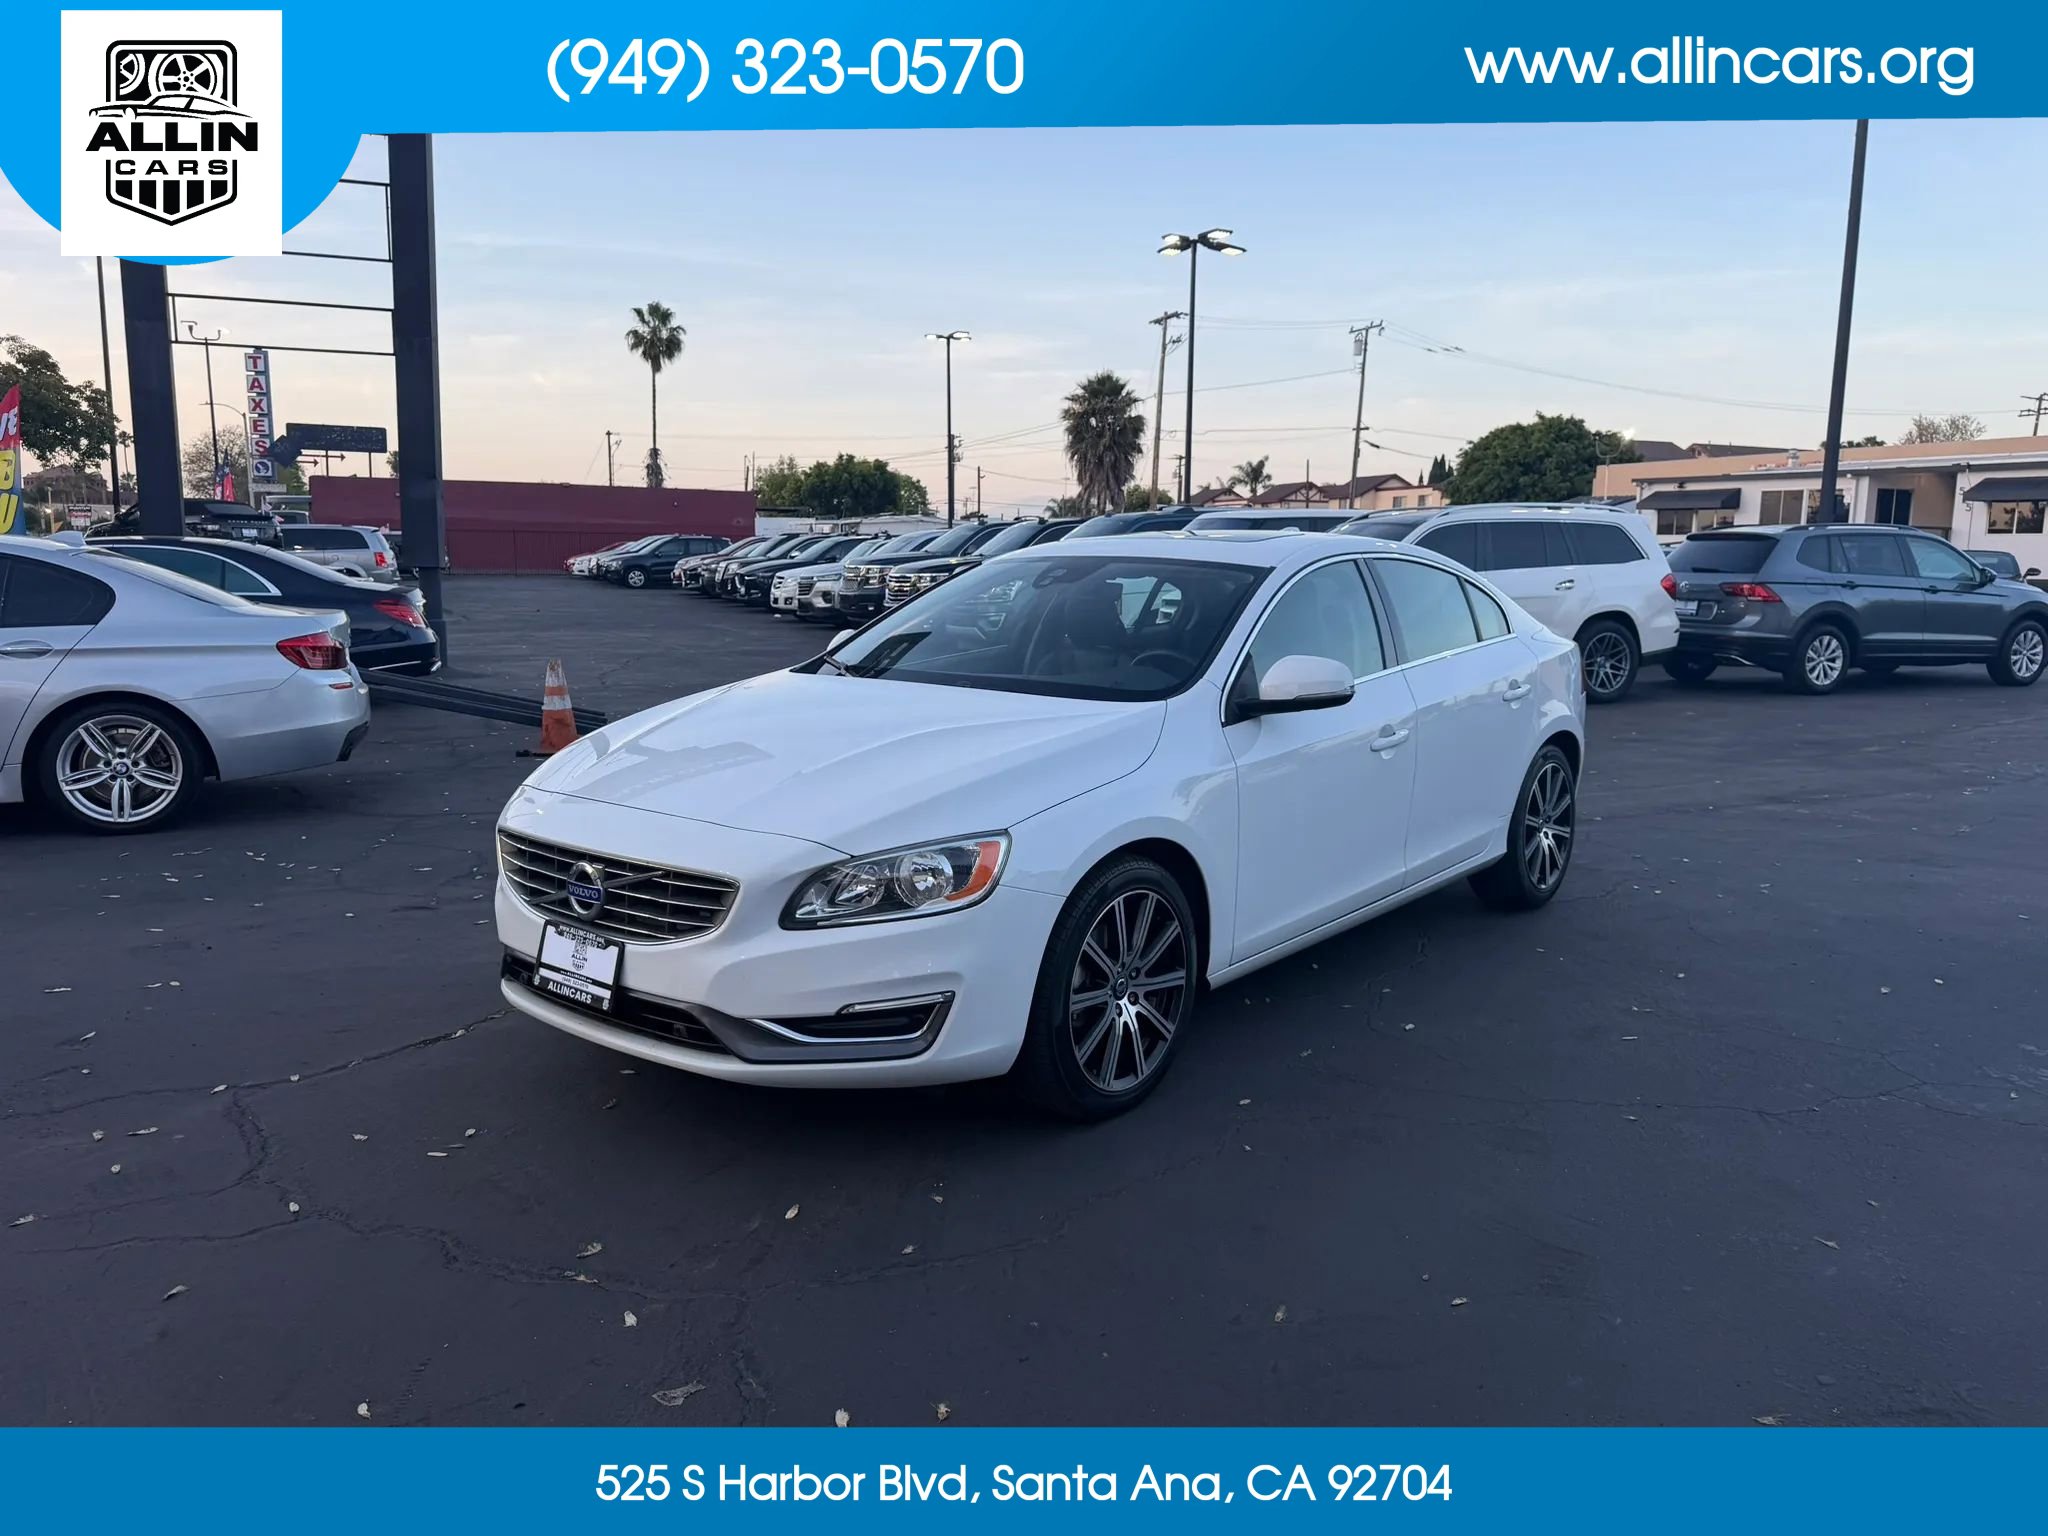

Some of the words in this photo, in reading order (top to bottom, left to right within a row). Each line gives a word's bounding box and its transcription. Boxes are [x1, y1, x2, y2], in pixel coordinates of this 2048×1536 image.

[248, 356, 270, 456] TAXES
[568, 884, 599, 899] VOLVO
[547, 980, 593, 1005] ALLINCARS
